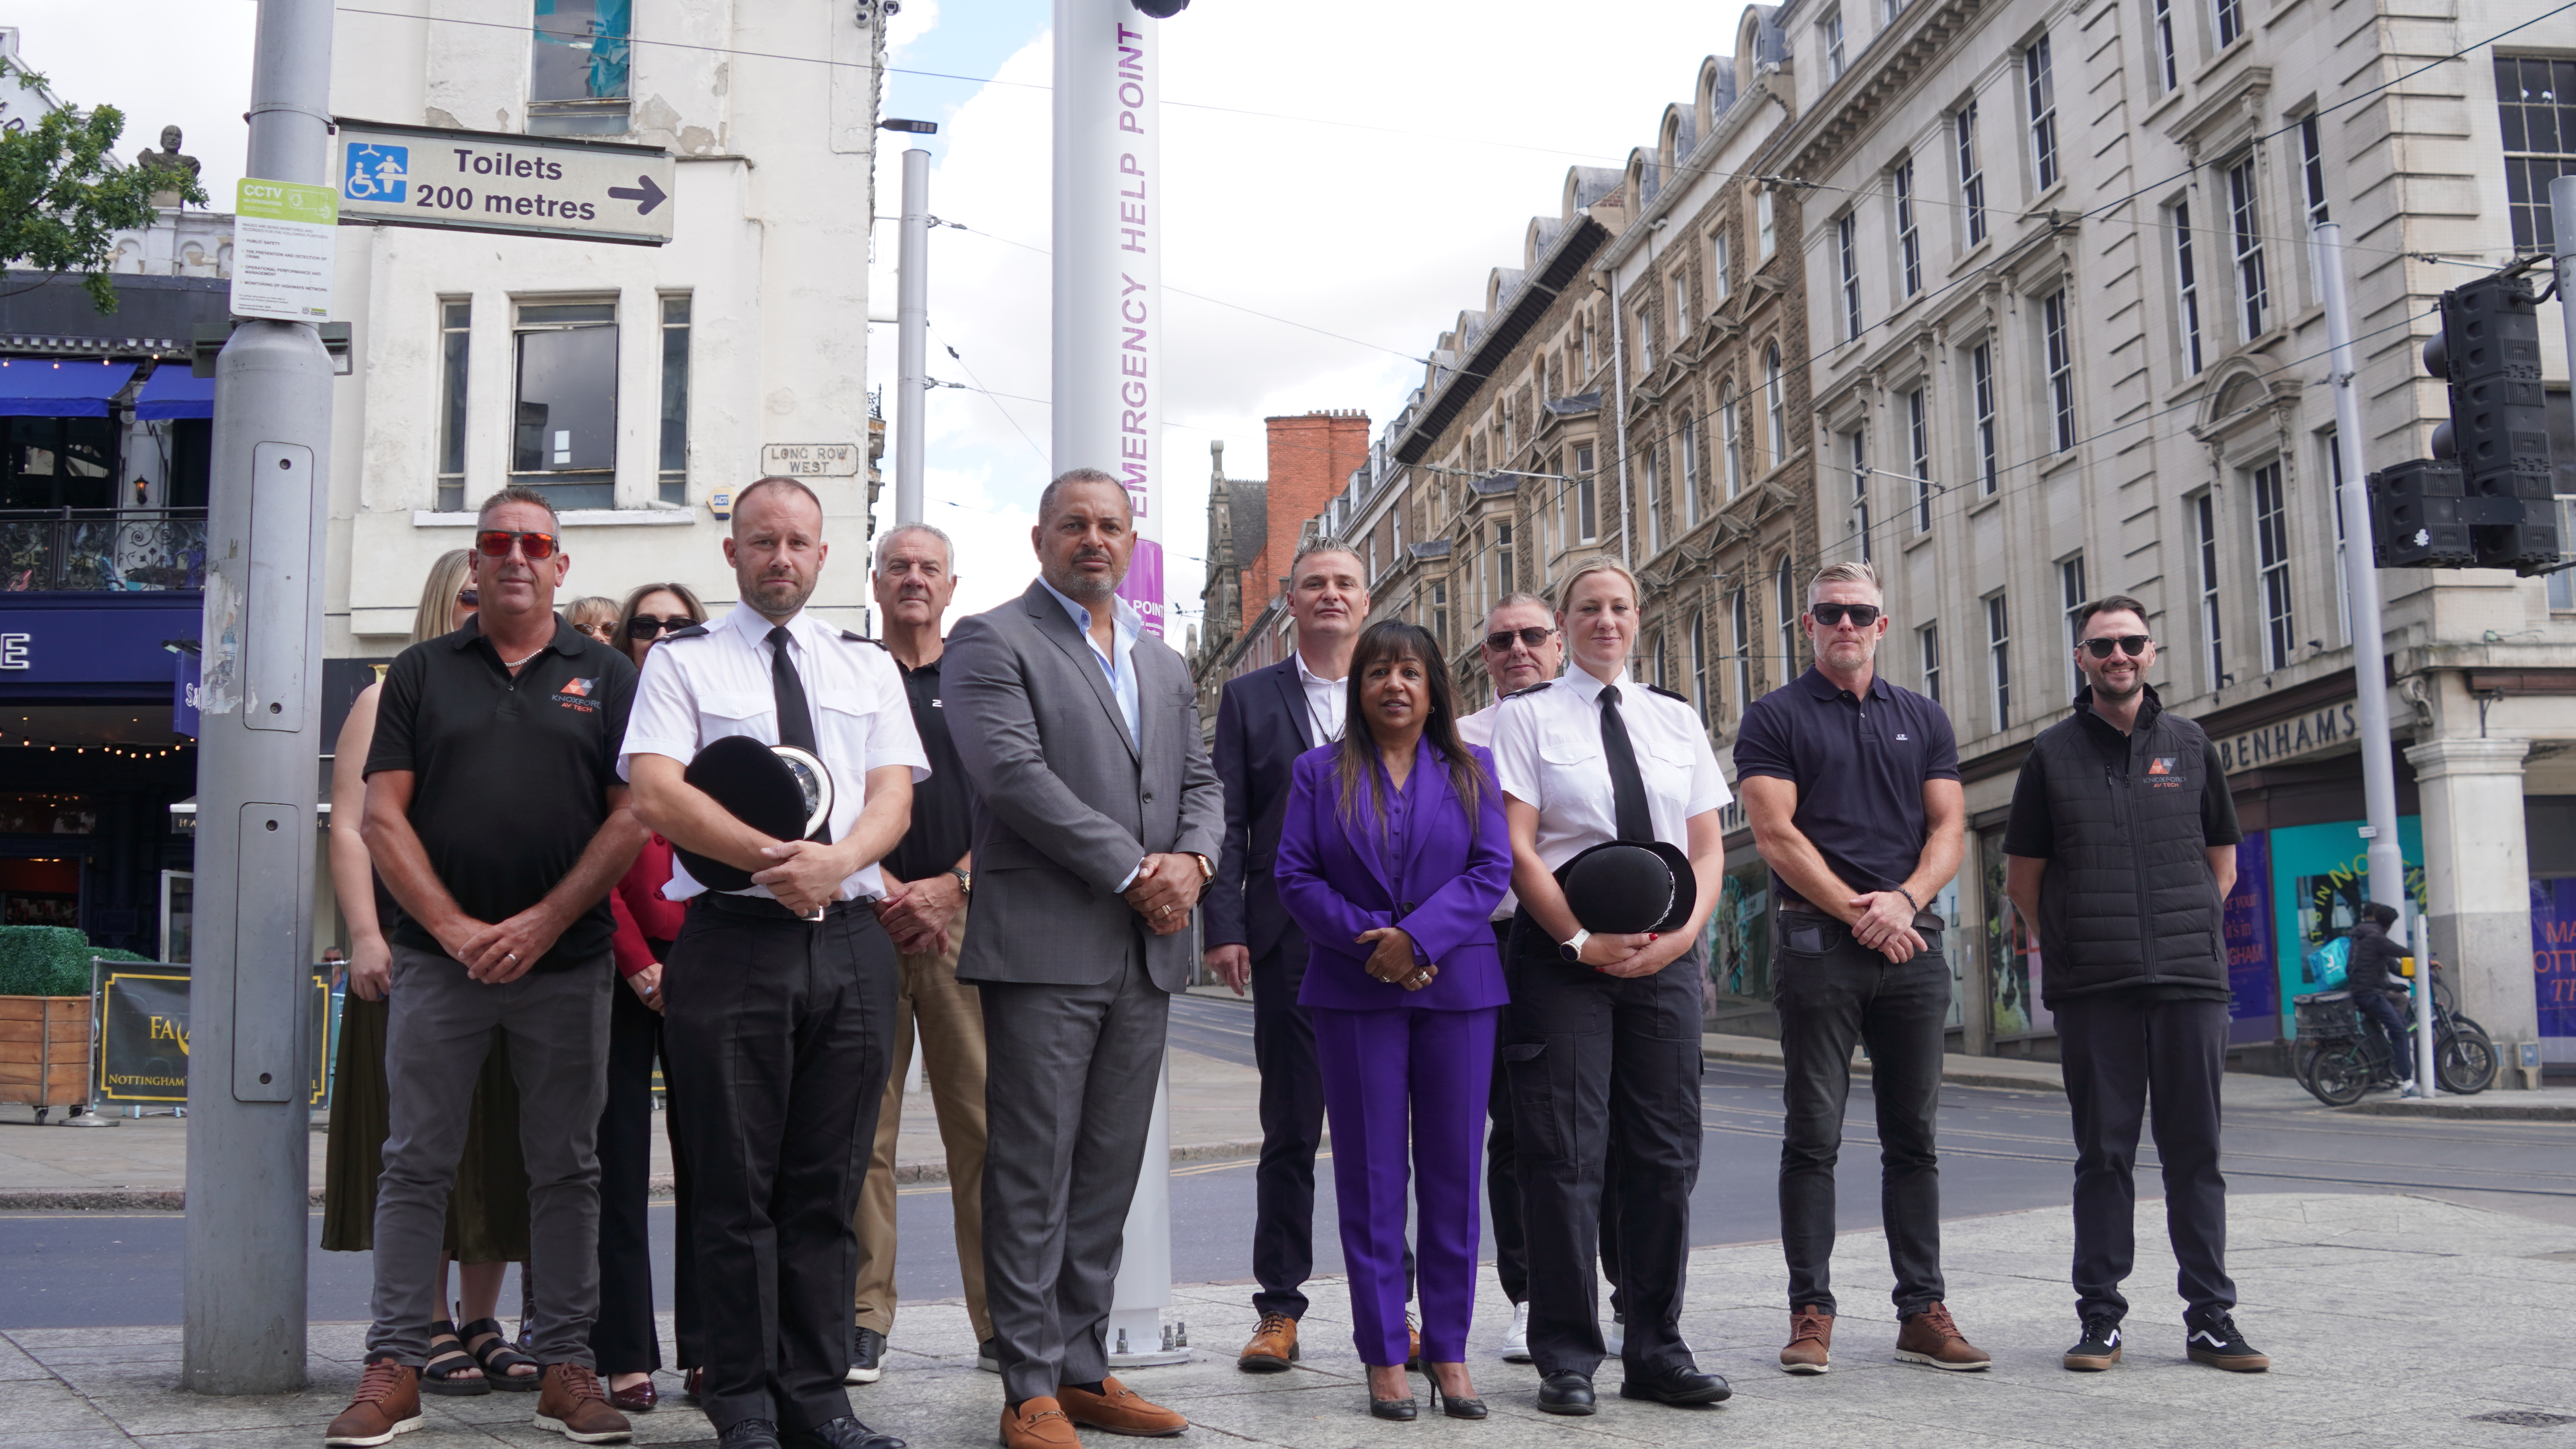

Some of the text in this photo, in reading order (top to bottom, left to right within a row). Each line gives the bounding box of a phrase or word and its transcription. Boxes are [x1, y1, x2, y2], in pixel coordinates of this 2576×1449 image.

[454, 149, 562, 180] Toilets
[244, 185, 283, 198] CCTV
[416, 184, 595, 221] 200 metres
[1118, 22, 1147, 518] EMERGENCY HELP POINT
[772, 448, 848, 460] LONG ROW
[790, 461, 829, 473] WEST
[1133, 600, 1163, 618] POINT
[573, 704, 592, 712] TECH
[2221, 703, 2356, 771] BENHAMS
[2236, 894, 2257, 913] your
